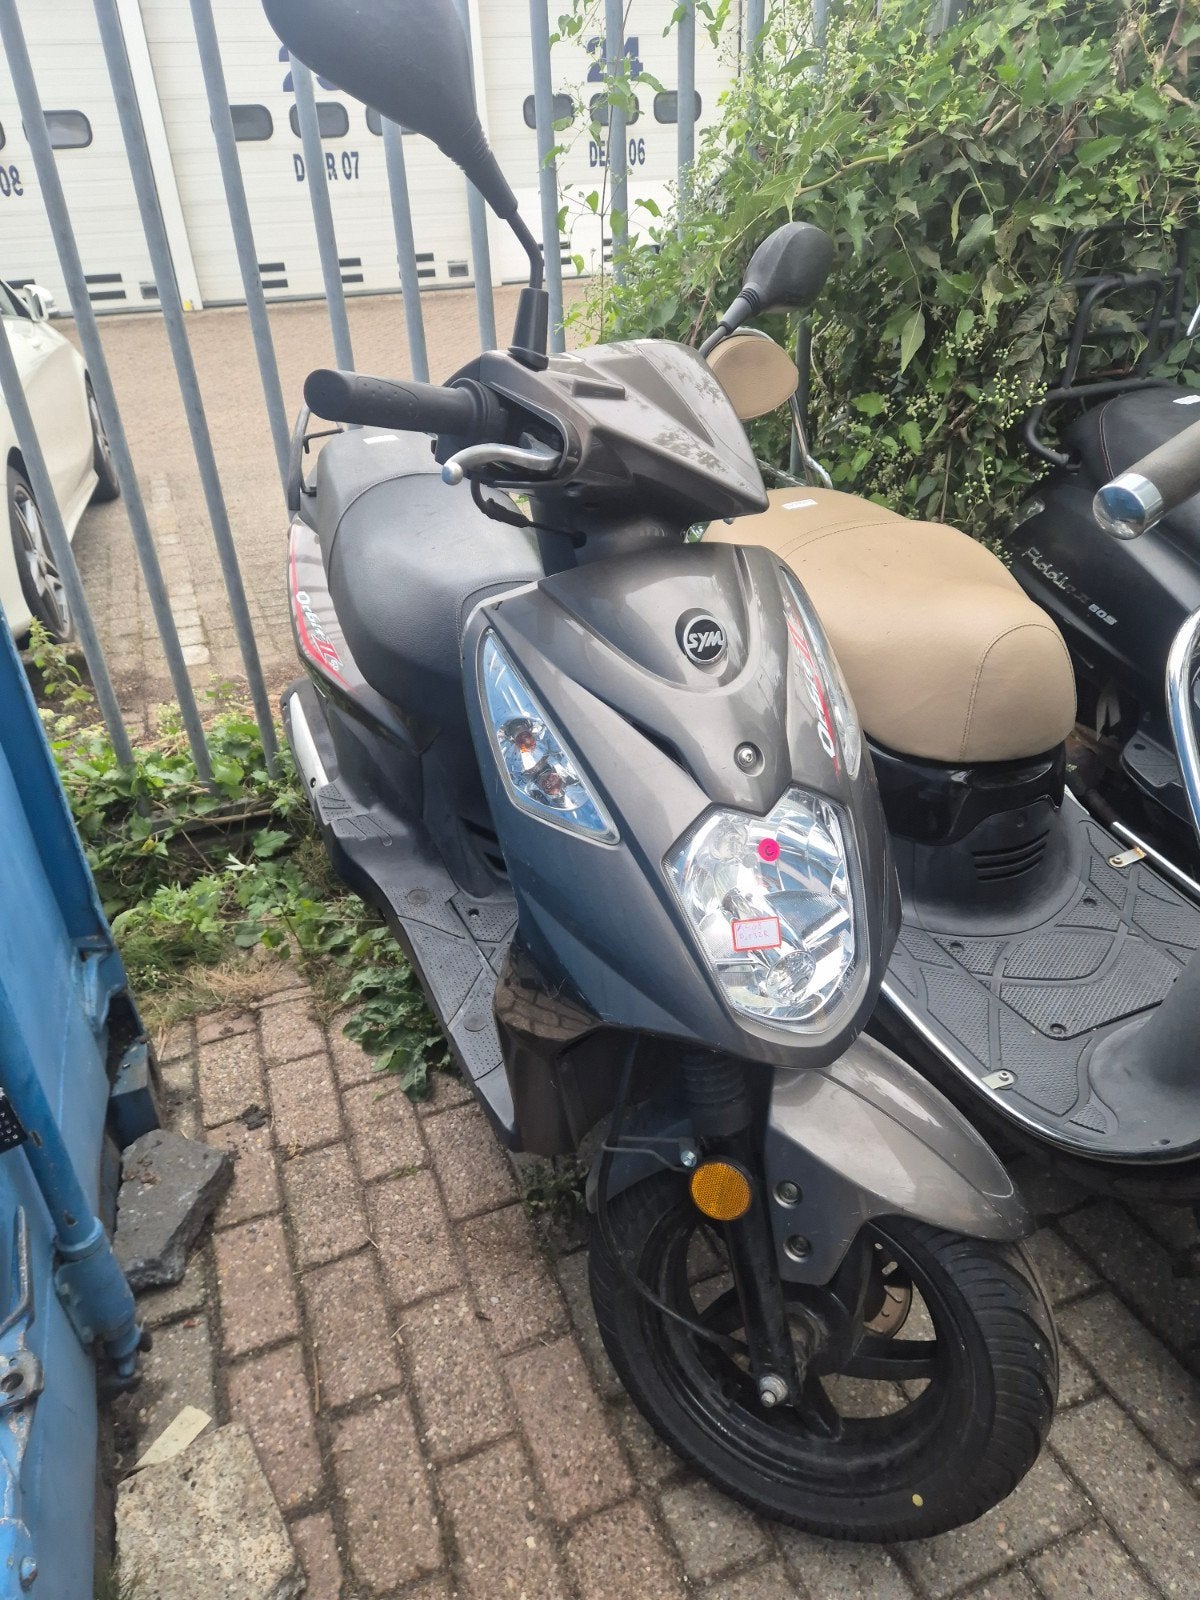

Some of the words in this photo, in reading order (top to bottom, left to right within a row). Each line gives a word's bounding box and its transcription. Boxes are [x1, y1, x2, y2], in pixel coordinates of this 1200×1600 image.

[341, 151, 359, 181] 07
[628, 138, 646, 167] 06
[687, 630, 725, 653] SYM
